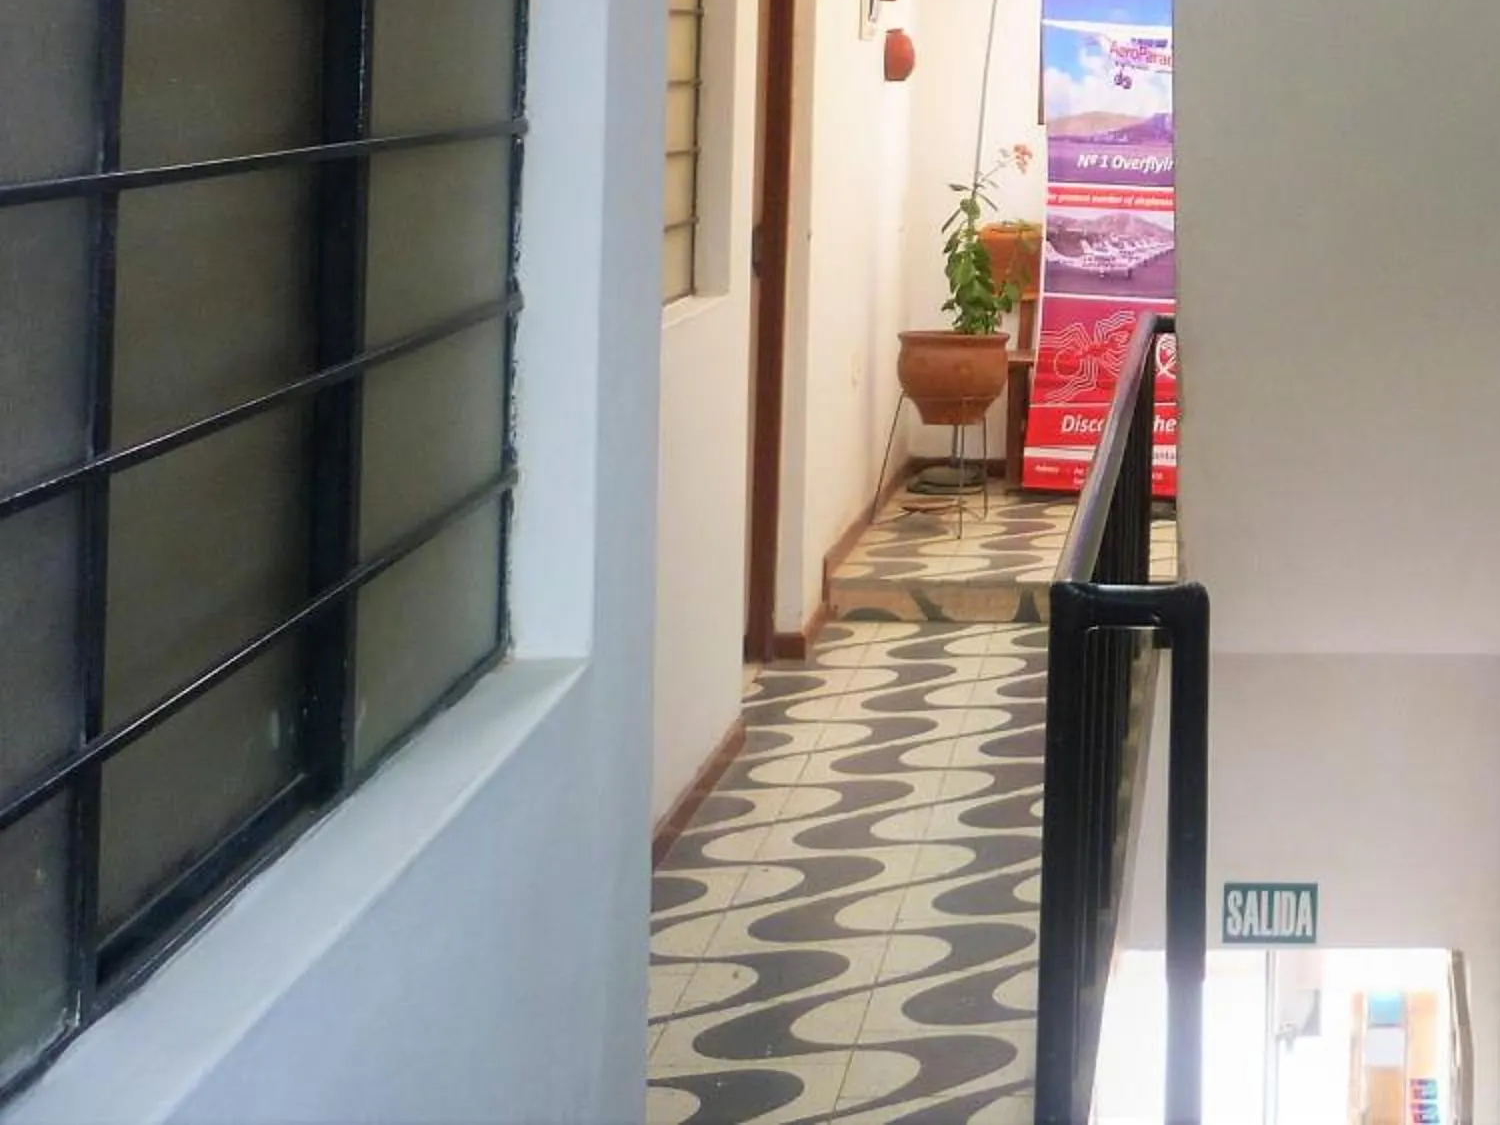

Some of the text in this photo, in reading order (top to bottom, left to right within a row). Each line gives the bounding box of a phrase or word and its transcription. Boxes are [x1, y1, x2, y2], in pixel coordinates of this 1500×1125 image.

[1100, 155, 1109, 168] 1
[1153, 414, 1177, 433] he
[1226, 889, 1313, 937] SALIDA
